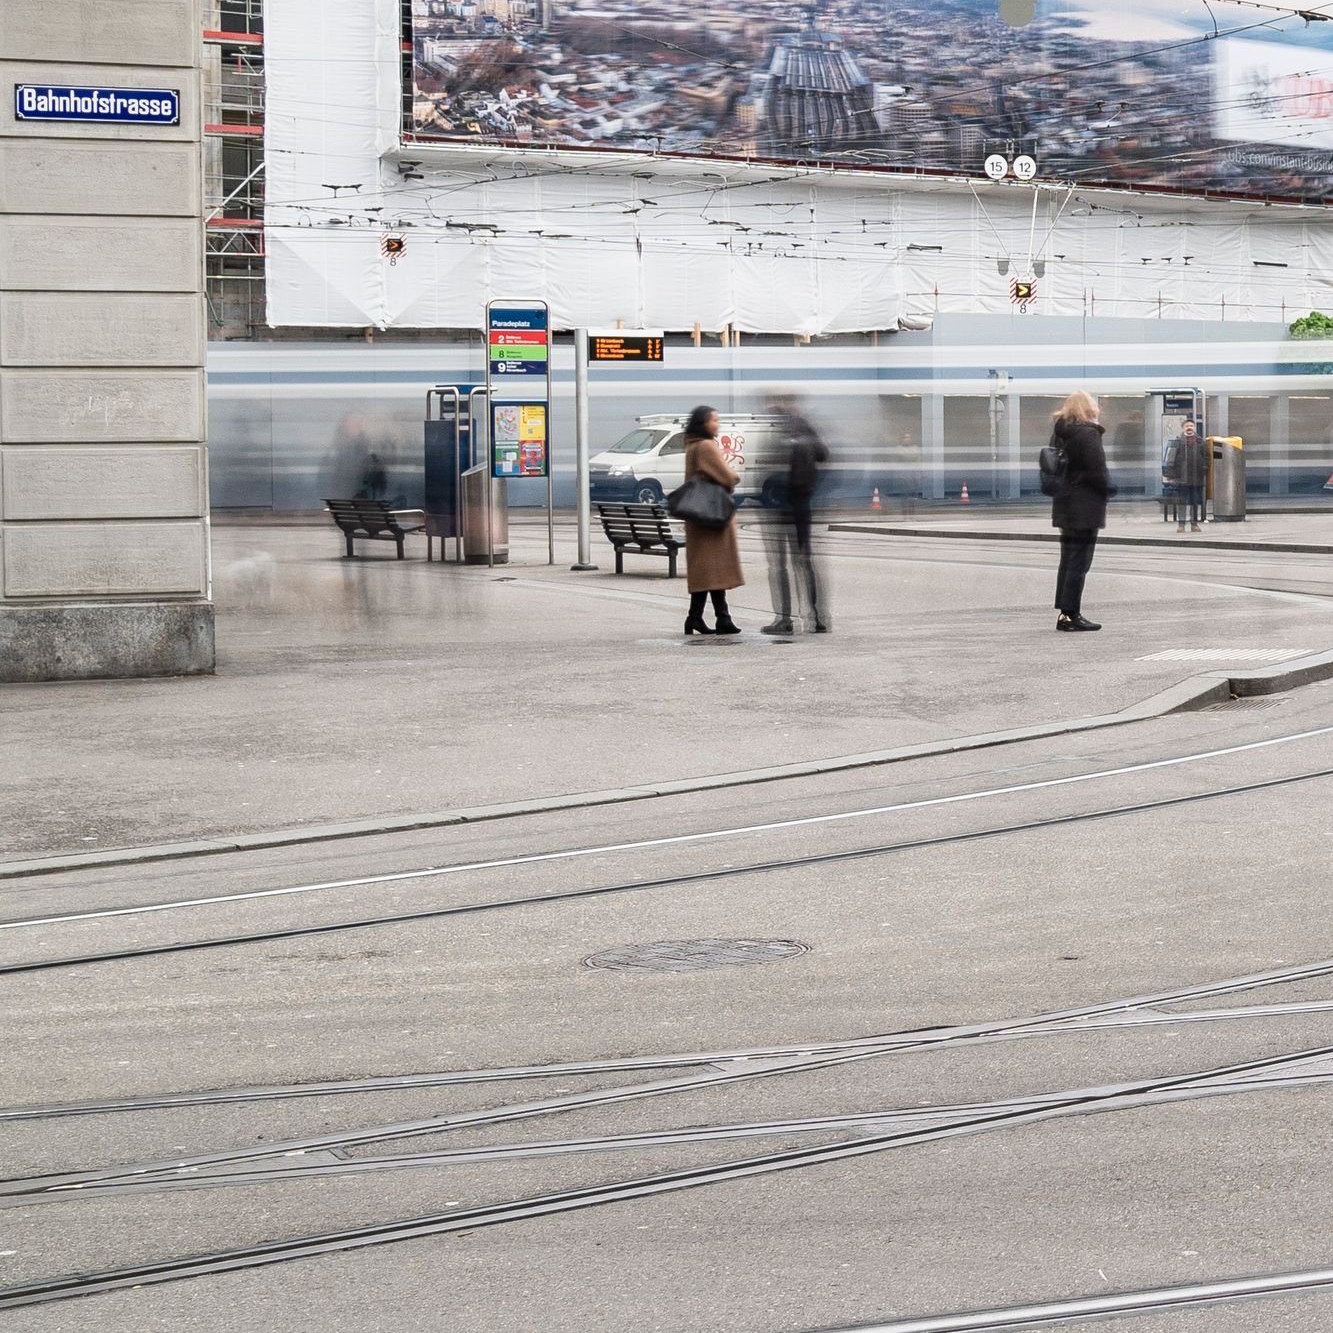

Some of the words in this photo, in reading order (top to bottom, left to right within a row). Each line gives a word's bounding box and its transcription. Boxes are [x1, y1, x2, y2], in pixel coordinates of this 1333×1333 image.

[23, 87, 172, 116] Bahnhofstrasse
[990, 162, 1002, 172] 15
[1019, 162, 1031, 173] 12
[390, 257, 397, 266] 8
[1019, 304, 1027, 314] 8
[492, 320, 530, 328] Paradeplatz
[498, 335, 505, 344] 2
[498, 350, 505, 359] 8
[497, 362, 506, 373] 9
